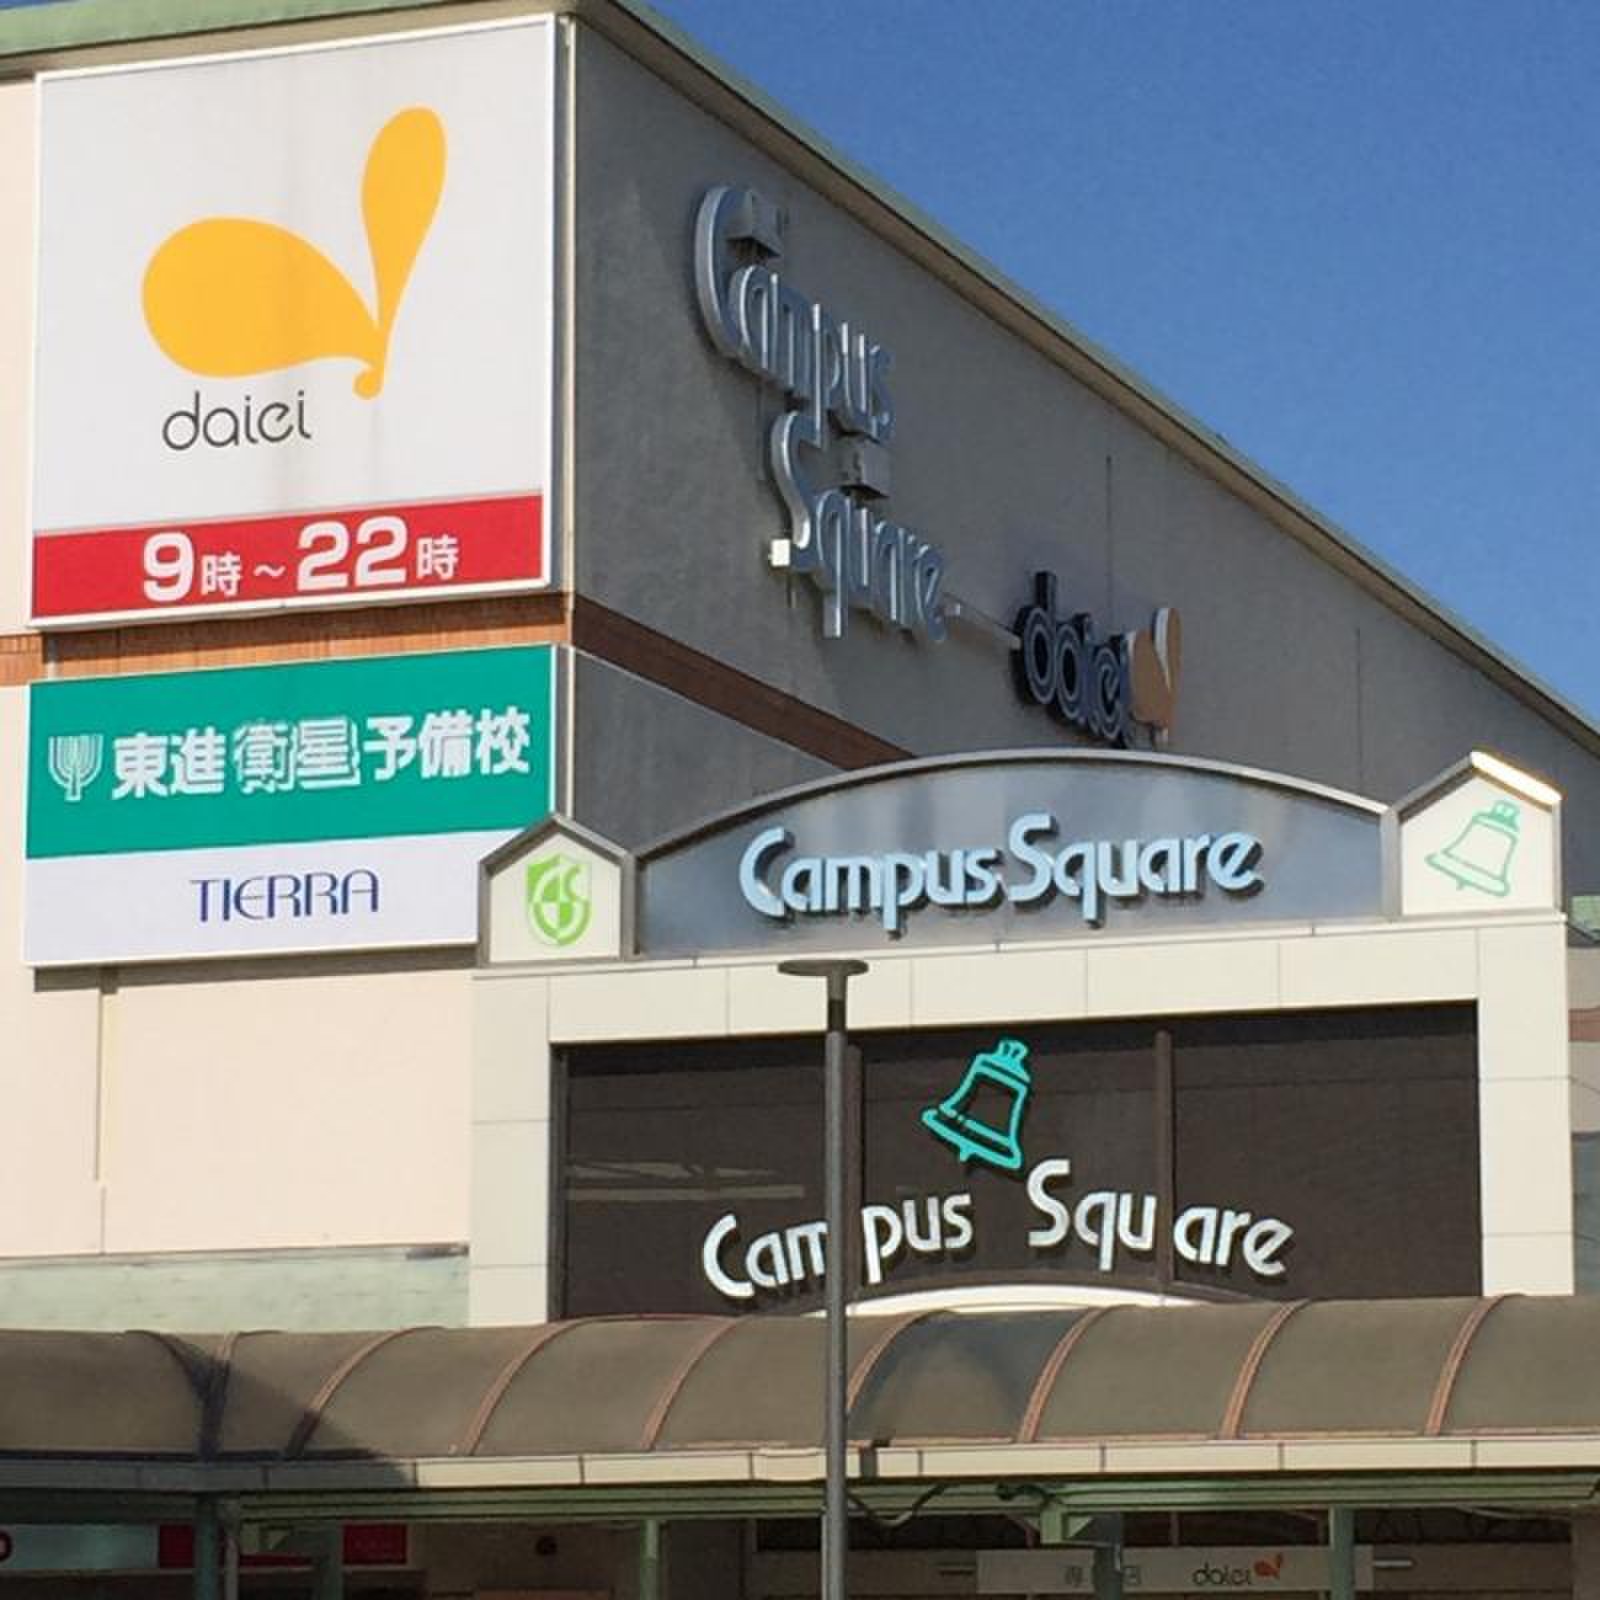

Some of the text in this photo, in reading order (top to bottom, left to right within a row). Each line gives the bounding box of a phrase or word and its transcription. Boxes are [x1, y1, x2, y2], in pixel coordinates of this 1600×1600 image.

[163, 392, 312, 450] daiei
[111, 706, 531, 800] 東進衛星予備校
[189, 869, 379, 923] TIERRA
[739, 812, 1264, 934] Campus Square
